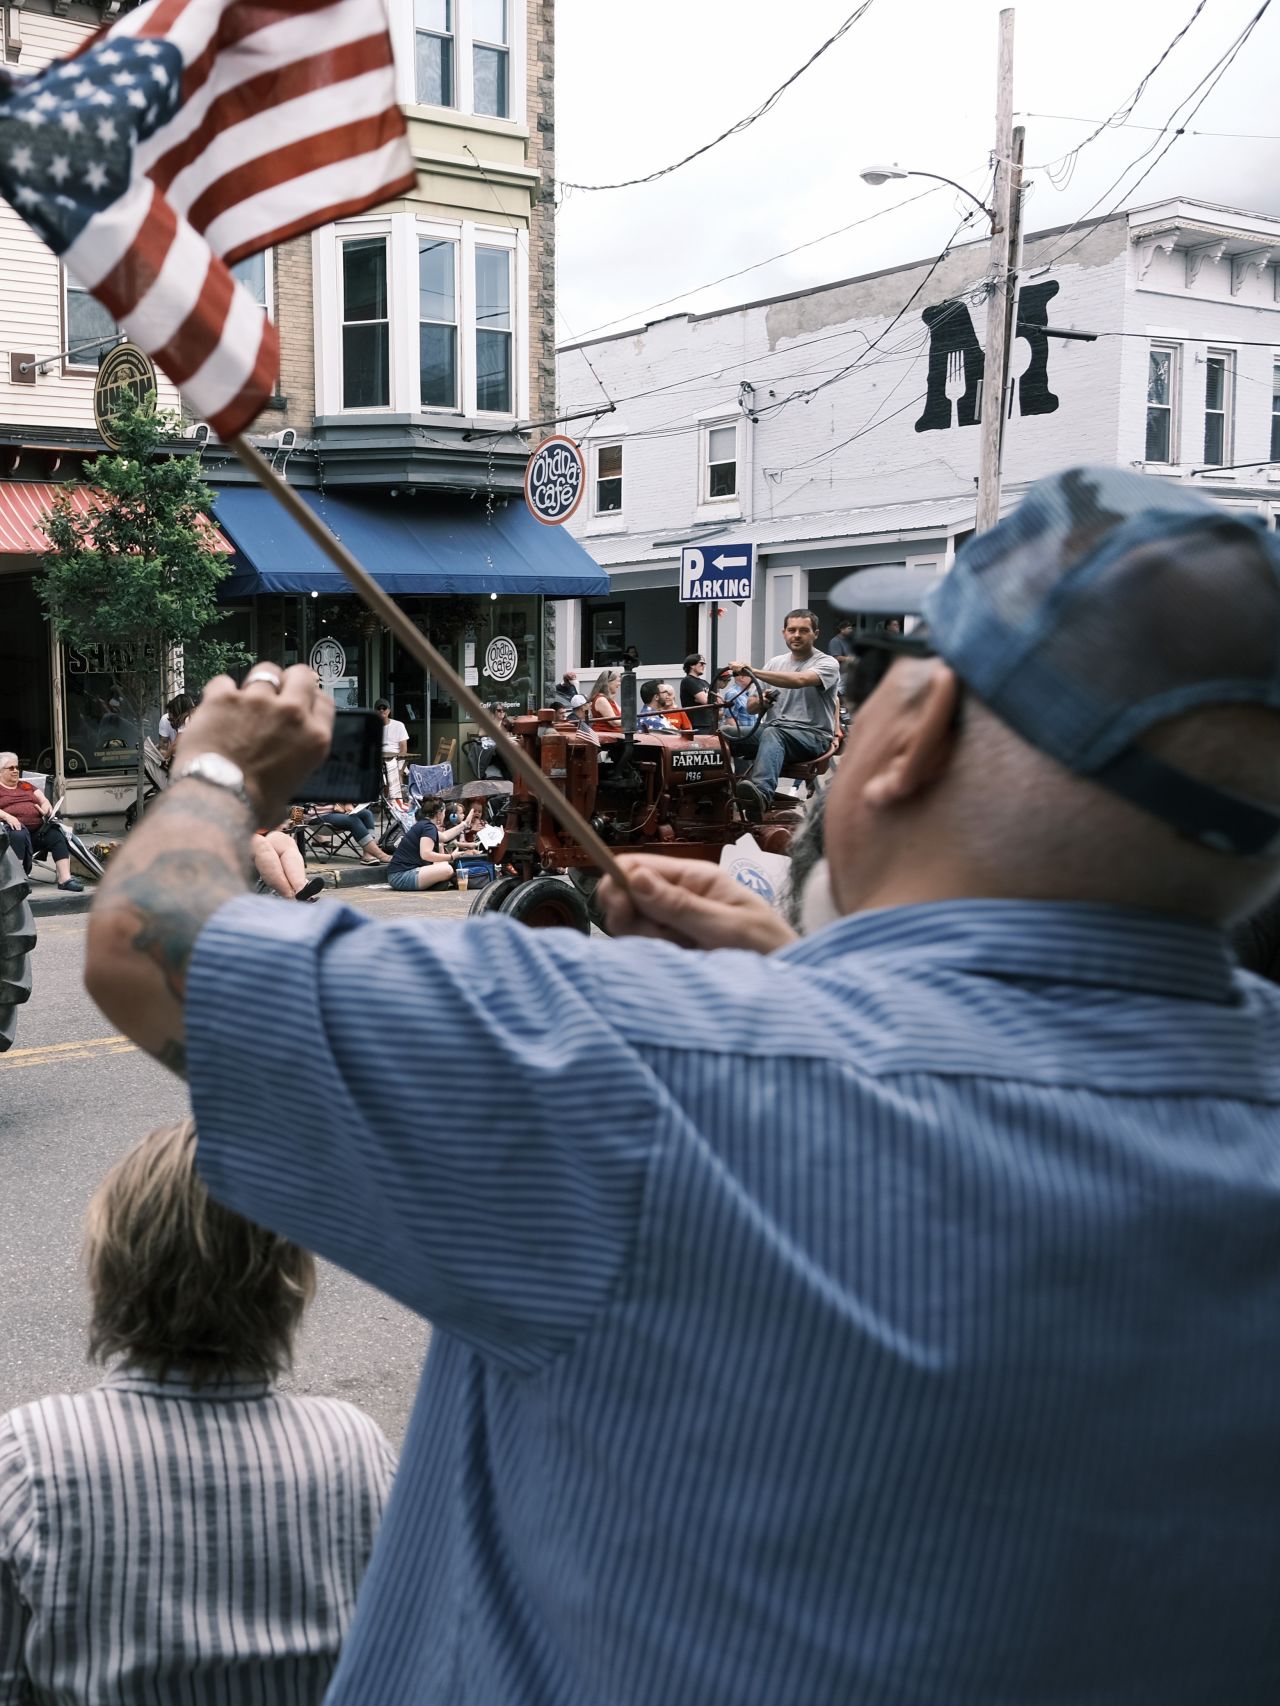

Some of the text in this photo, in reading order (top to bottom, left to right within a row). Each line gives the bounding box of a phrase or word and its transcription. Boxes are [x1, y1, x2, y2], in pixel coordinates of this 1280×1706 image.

[97, 377, 153, 419] UNON
[682, 549, 750, 599] PARKING
[672, 754, 723, 767] FARMALL
[685, 771, 702, 781] 1936
